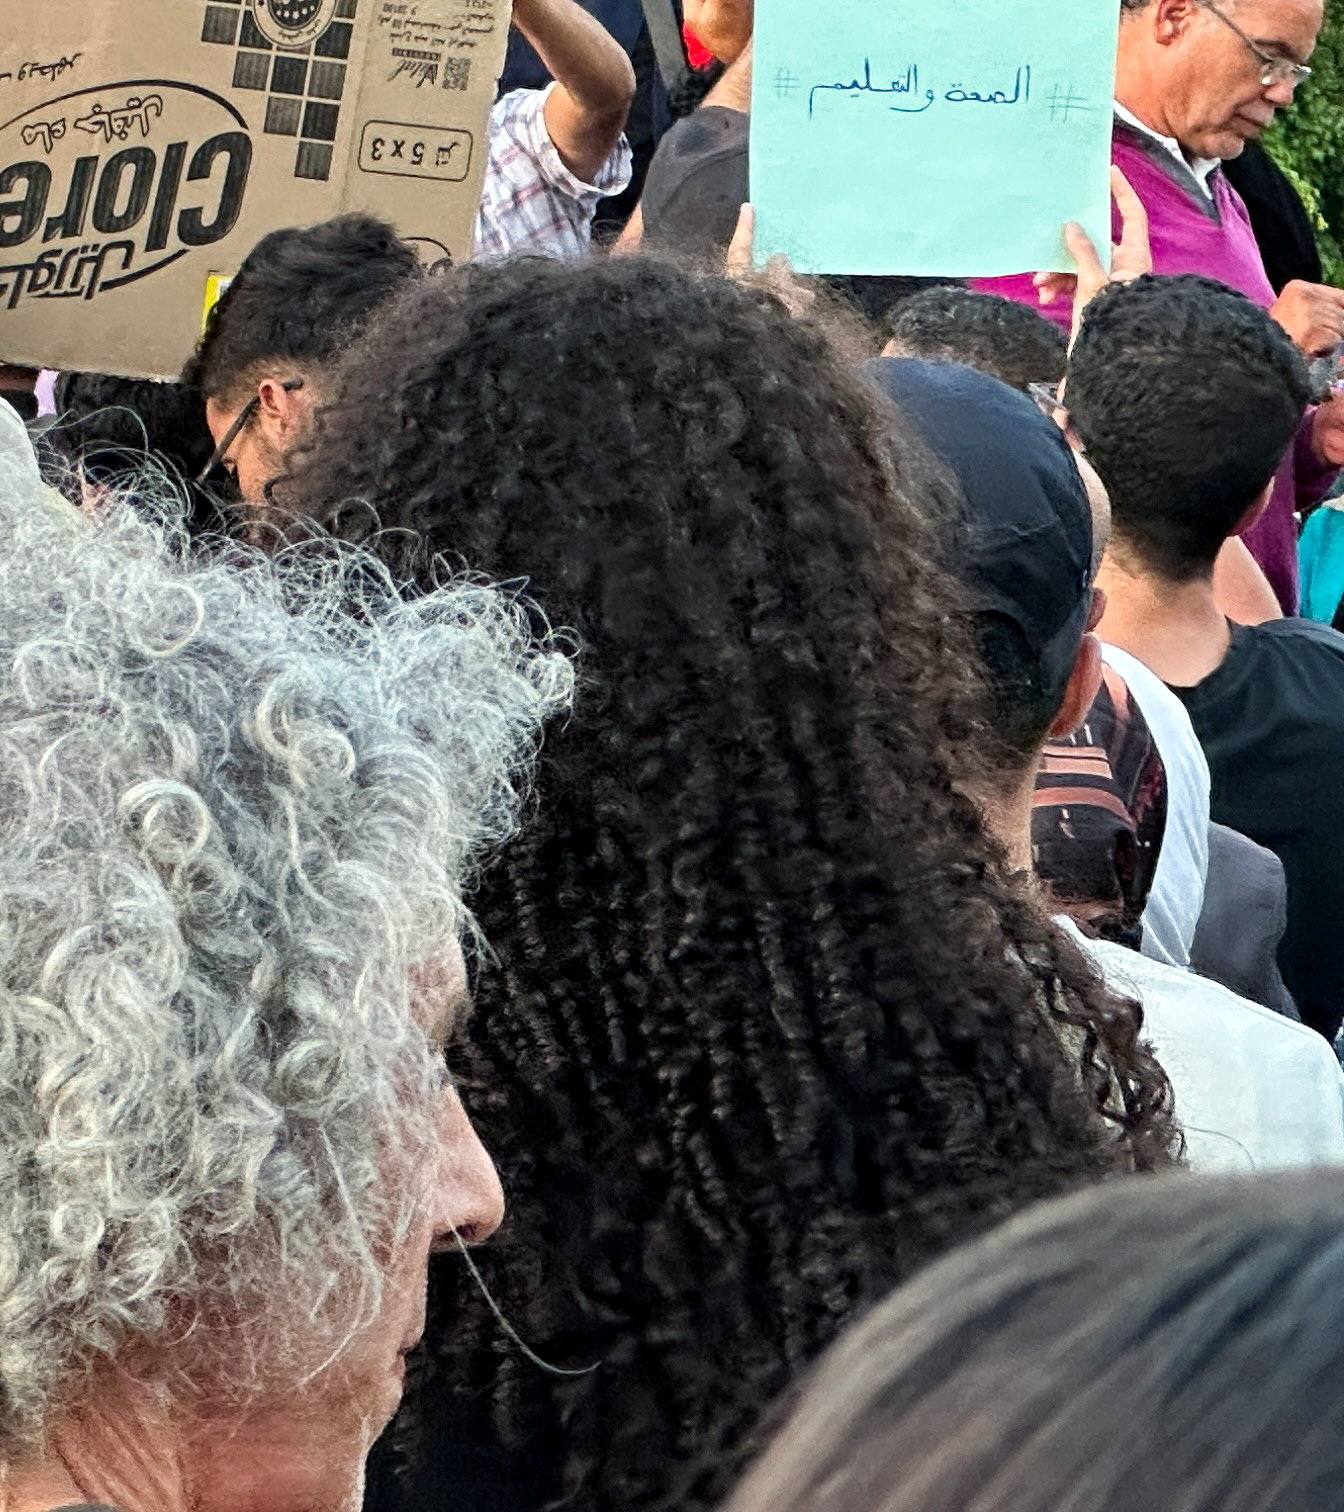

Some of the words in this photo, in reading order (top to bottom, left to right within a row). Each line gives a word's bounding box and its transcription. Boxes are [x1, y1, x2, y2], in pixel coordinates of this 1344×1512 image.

[943, 64, 1031, 105] الصحة
[20, 117, 66, 154] ماء
[73, 94, 163, 143] جافيل
[370, 137, 386, 161] 3
[390, 139, 406, 159] x
[410, 141, 425, 165] 5
